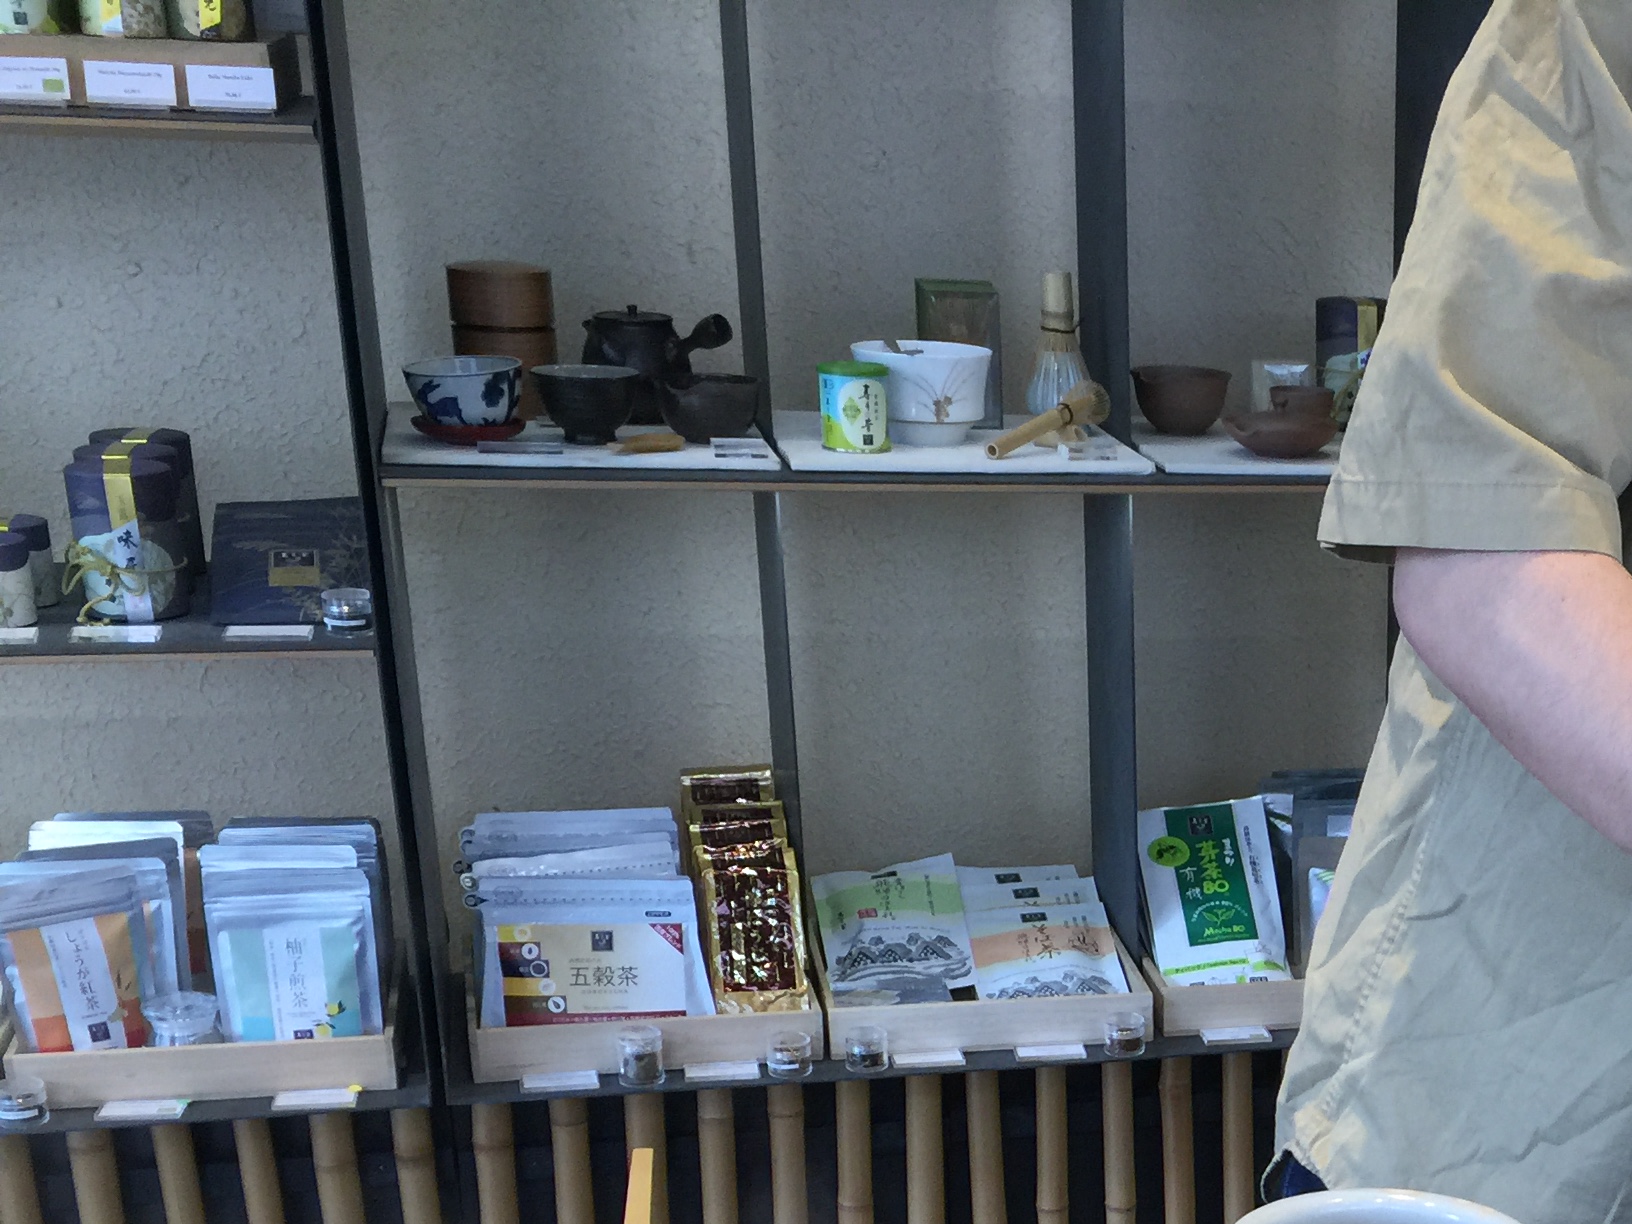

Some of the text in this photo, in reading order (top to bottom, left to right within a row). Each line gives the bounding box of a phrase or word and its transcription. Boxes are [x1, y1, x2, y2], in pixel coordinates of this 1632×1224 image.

[65, 931, 100, 1012] しょうが紅茶
[285, 938, 309, 1009] 柚子煎茶
[568, 965, 639, 988] 五穀茶
